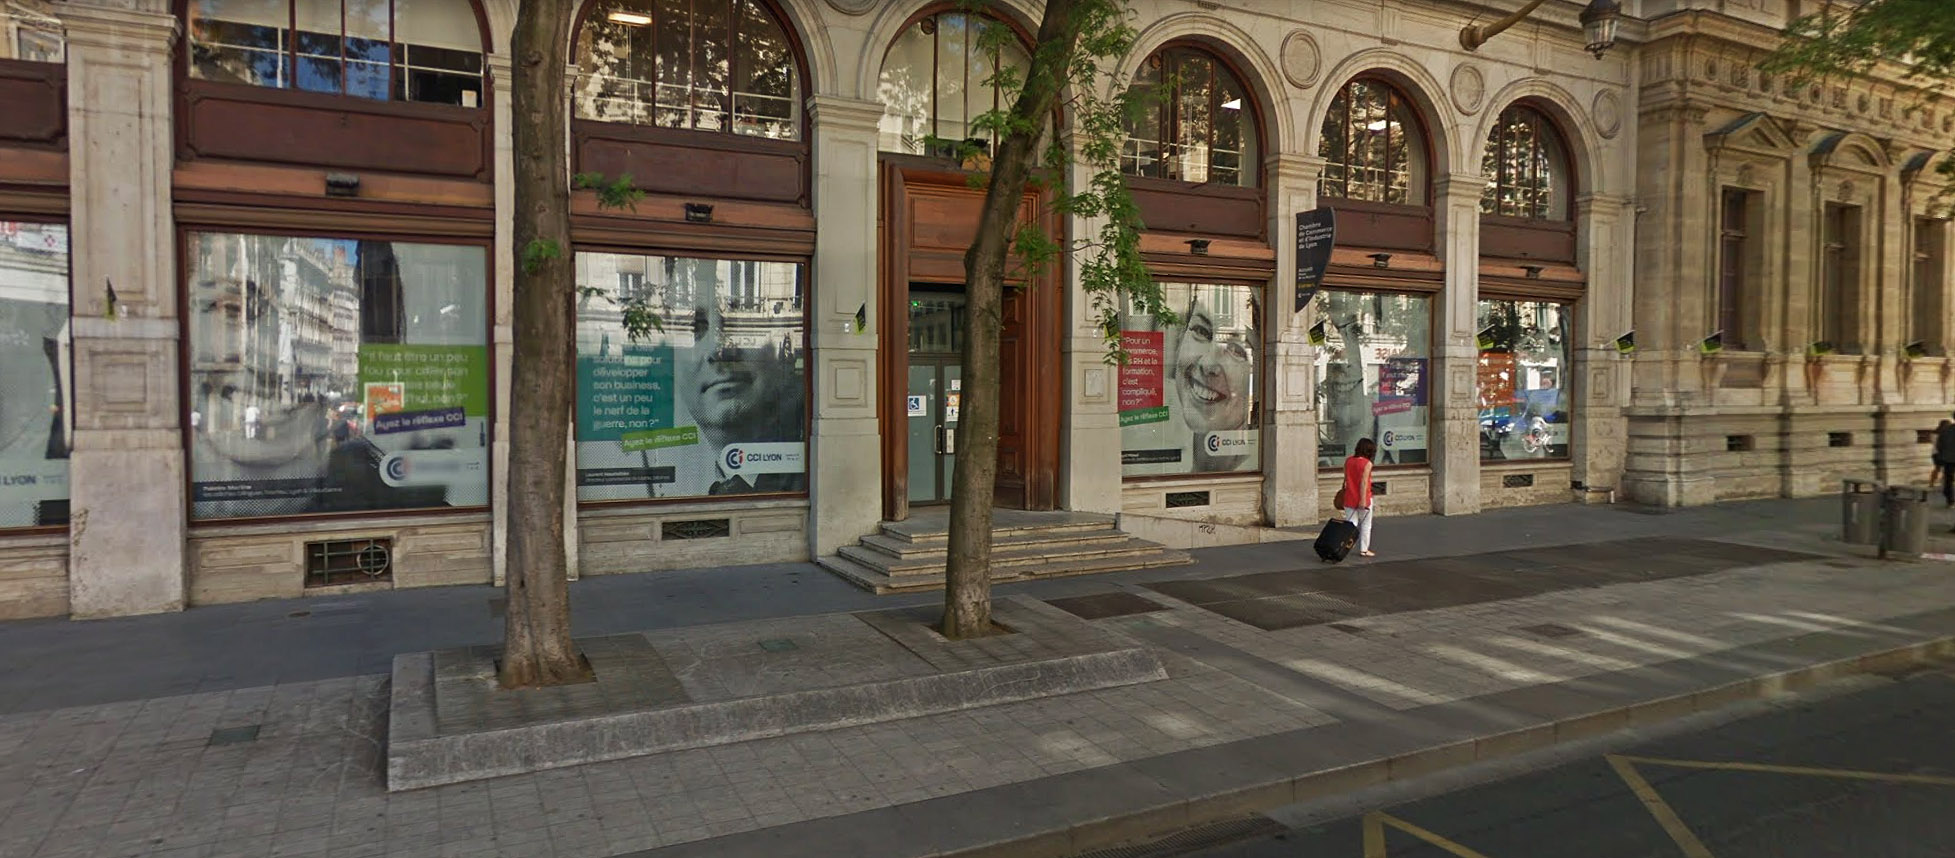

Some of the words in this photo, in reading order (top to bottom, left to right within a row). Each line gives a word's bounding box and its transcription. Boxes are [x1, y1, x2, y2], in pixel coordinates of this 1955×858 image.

[1299, 222, 1321, 231] Chambre
[1306, 227, 1332, 236] Commerce
[378, 351, 401, 362] faut
[446, 354, 468, 364] peu
[364, 366, 383, 376] fou
[386, 368, 411, 378] pour
[593, 367, 649, 378] développer
[1123, 367, 1155, 376] formation,
[614, 381, 661, 391] business,
[1122, 388, 1157, 396] compliqué,
[593, 394, 617, 402] c'est
[634, 395, 653, 404] peu
[593, 406, 602, 415] le
[604, 405, 624, 415] nerf
[626, 406, 639, 415] de
[641, 406, 650, 415] la
[375, 420, 400, 430] Ayez
[401, 417, 411, 426] le
[412, 414, 445, 424] réflexe
[446, 412, 463, 421] CCI
[1121, 416, 1133, 424] Ayez
[1141, 412, 1158, 420] réflexe
[624, 439, 644, 448] Ayez
[654, 434, 681, 443] réflexe
[682, 432, 696, 440] CCI
[746, 453, 762, 462] CCI
[763, 453, 782, 462] LYON
[3, 475, 37, 486] LYON
